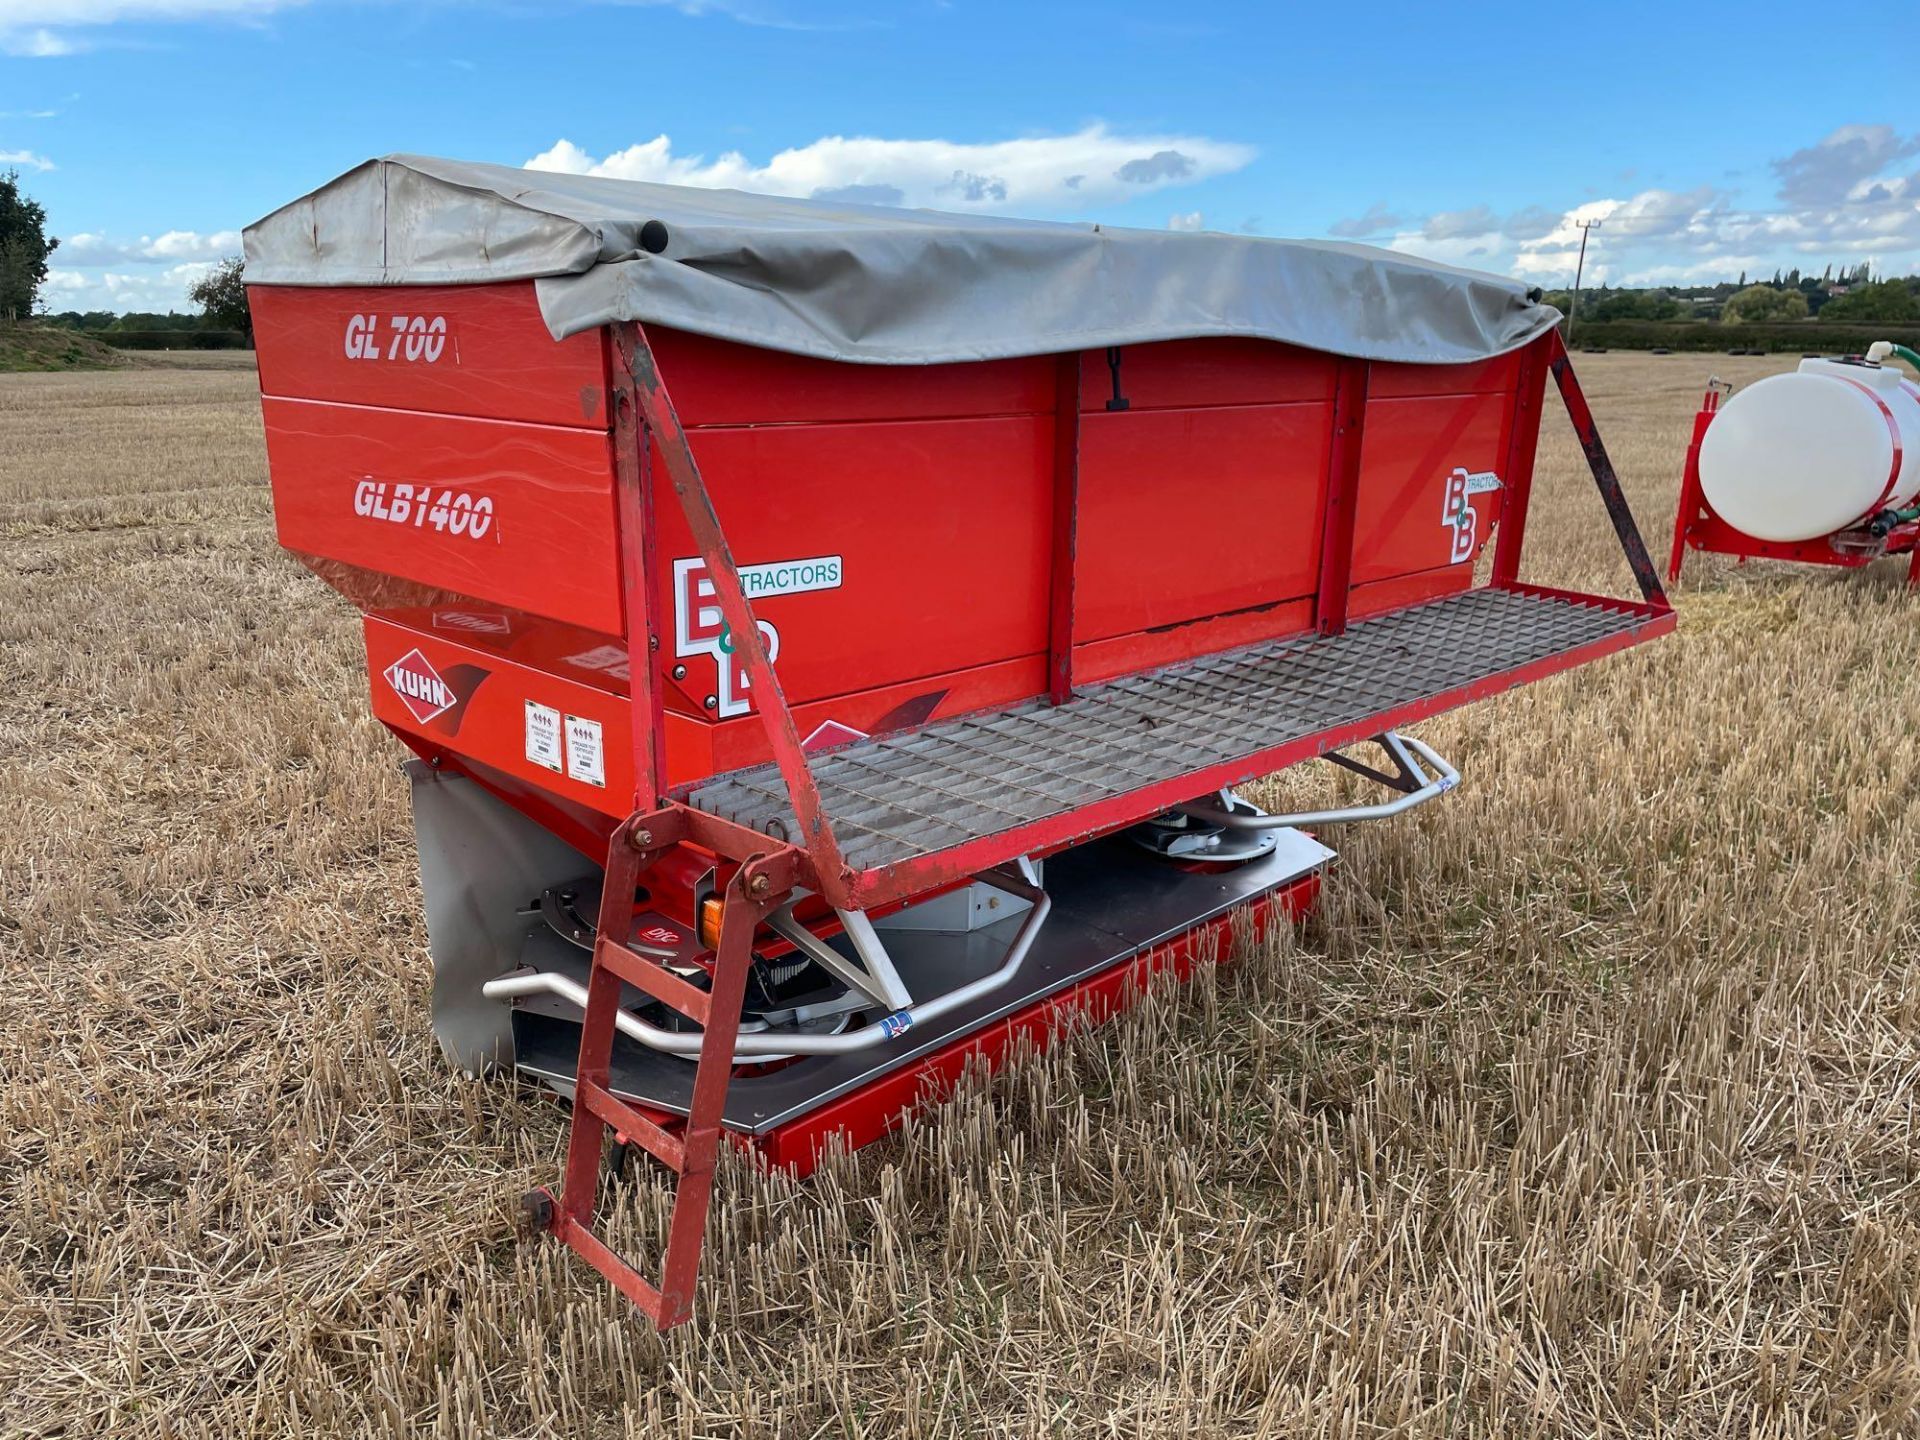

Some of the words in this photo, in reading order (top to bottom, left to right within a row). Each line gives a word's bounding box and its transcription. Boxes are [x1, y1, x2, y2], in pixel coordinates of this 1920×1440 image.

[345, 314, 379, 359] GL
[388, 316, 446, 362] 700
[740, 563, 838, 592] TRACTORS
[393, 665, 446, 709] KUHN
